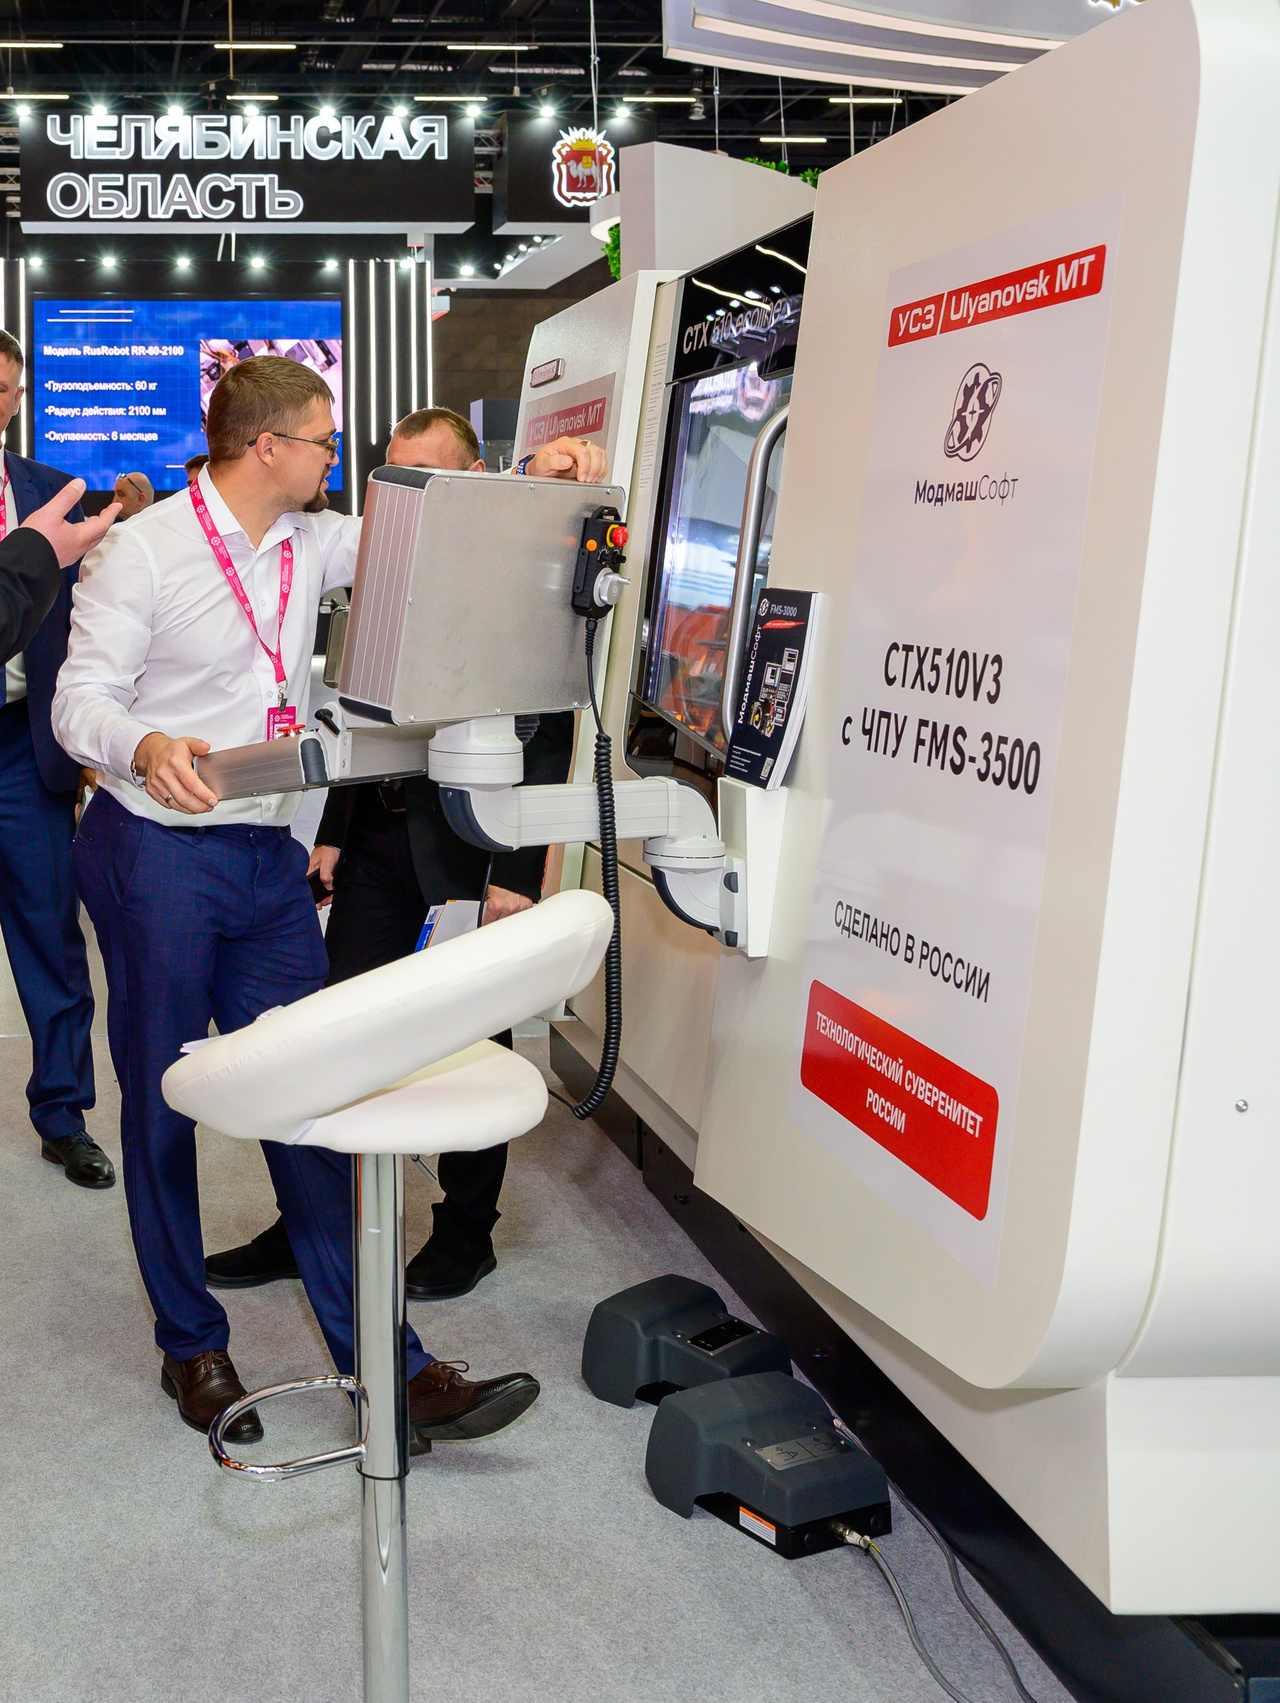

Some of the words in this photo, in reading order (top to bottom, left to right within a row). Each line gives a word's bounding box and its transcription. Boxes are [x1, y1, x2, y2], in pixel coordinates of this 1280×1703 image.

[47, 115, 448, 160] ЧЕЛЯБИНСКАЯ
[47, 172, 304, 219] ОБЛАСТЬ
[897, 304, 936, 337] УСЗ
[949, 269, 1050, 324] Ulyanovsk
[1054, 254, 1096, 293] MT
[43, 345, 82, 358] Модель
[82, 345, 130, 356] RusRobot
[131, 345, 184, 356] RR-60-2100
[683, 321, 710, 354] CTX
[712, 312, 733, 344] 510
[135, 380, 147, 391] 60
[148, 382, 158, 391] кг
[81, 405, 127, 418] действия:
[128, 405, 151, 416] 2100
[152, 407, 167, 416] мм
[549, 408, 587, 439] Ulyanovsk
[587, 403, 603, 426] MT
[111, 431, 119, 441] 6
[119, 432, 158, 443] месяцев
[914, 471, 1019, 507] МодмашСофт
[770, 603, 798, 618] FMS-3000
[737, 625, 762, 724] МодмашСофт
[883, 641, 1004, 705] CTX510V3
[861, 706, 908, 759] ЧПУ
[912, 718, 1041, 795] FMS-3500
[834, 900, 901, 957] СДЕЛАНО
[903, 932, 916, 965] В
[917, 940, 991, 1003] РОССИИ
[815, 1010, 904, 1088] ТЕХНОЛОГИЧЕСКИЙ
[904, 1068, 983, 1139] СУВЕРЕНИТЕТ
[865, 1087, 907, 1134] РОССИИ
